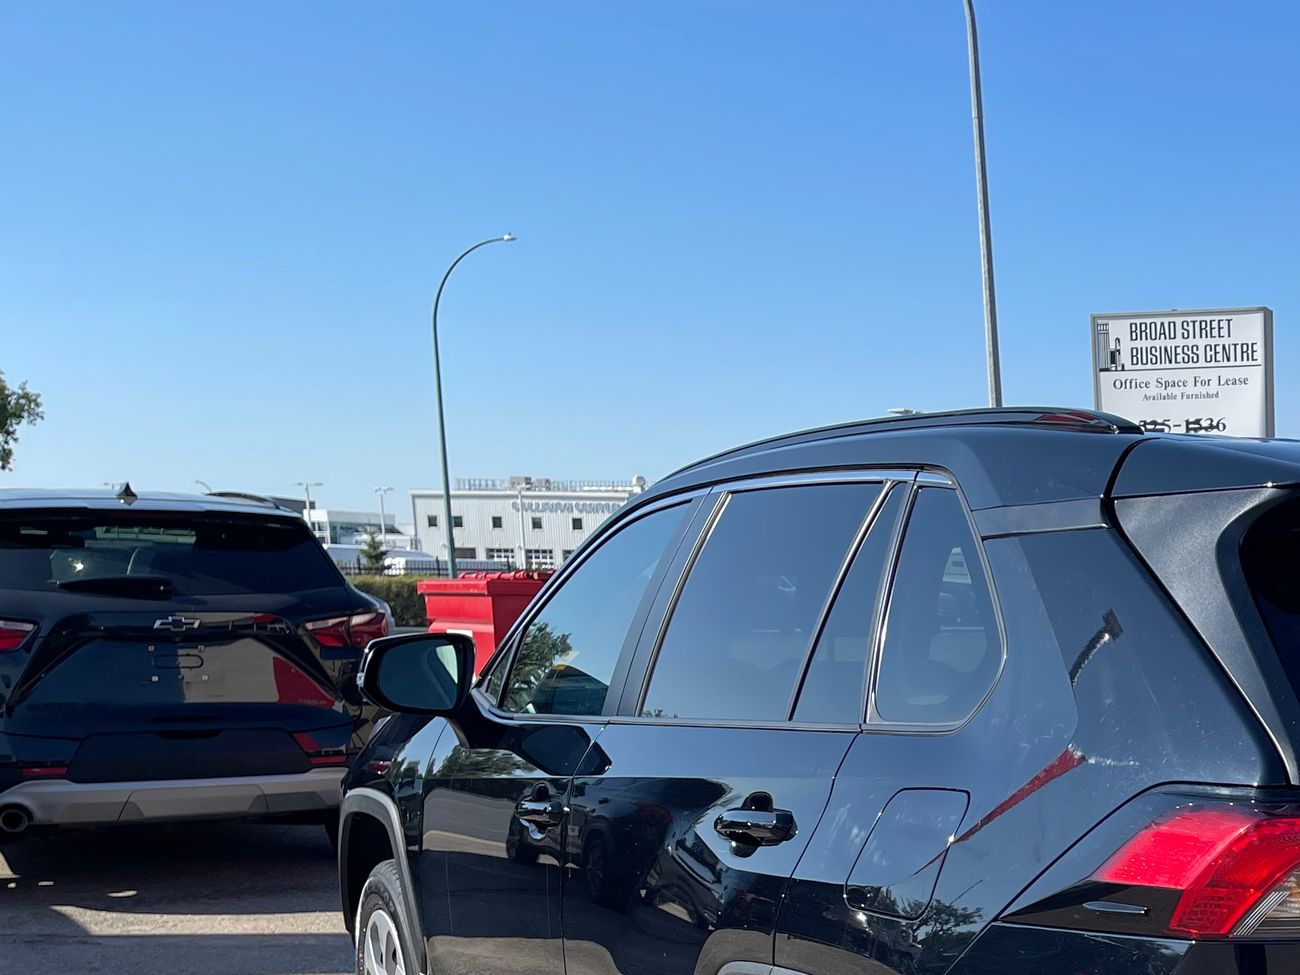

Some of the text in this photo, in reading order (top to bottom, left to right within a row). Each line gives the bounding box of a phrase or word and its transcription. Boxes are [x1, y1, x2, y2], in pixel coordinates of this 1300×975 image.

[1129, 318, 1233, 342] BROAD STREET
[1130, 342, 1258, 366] BUSINESS CENTRE
[1113, 375, 1249, 391] Office Space For Lease
[1142, 391, 1220, 402] Available Furnished
